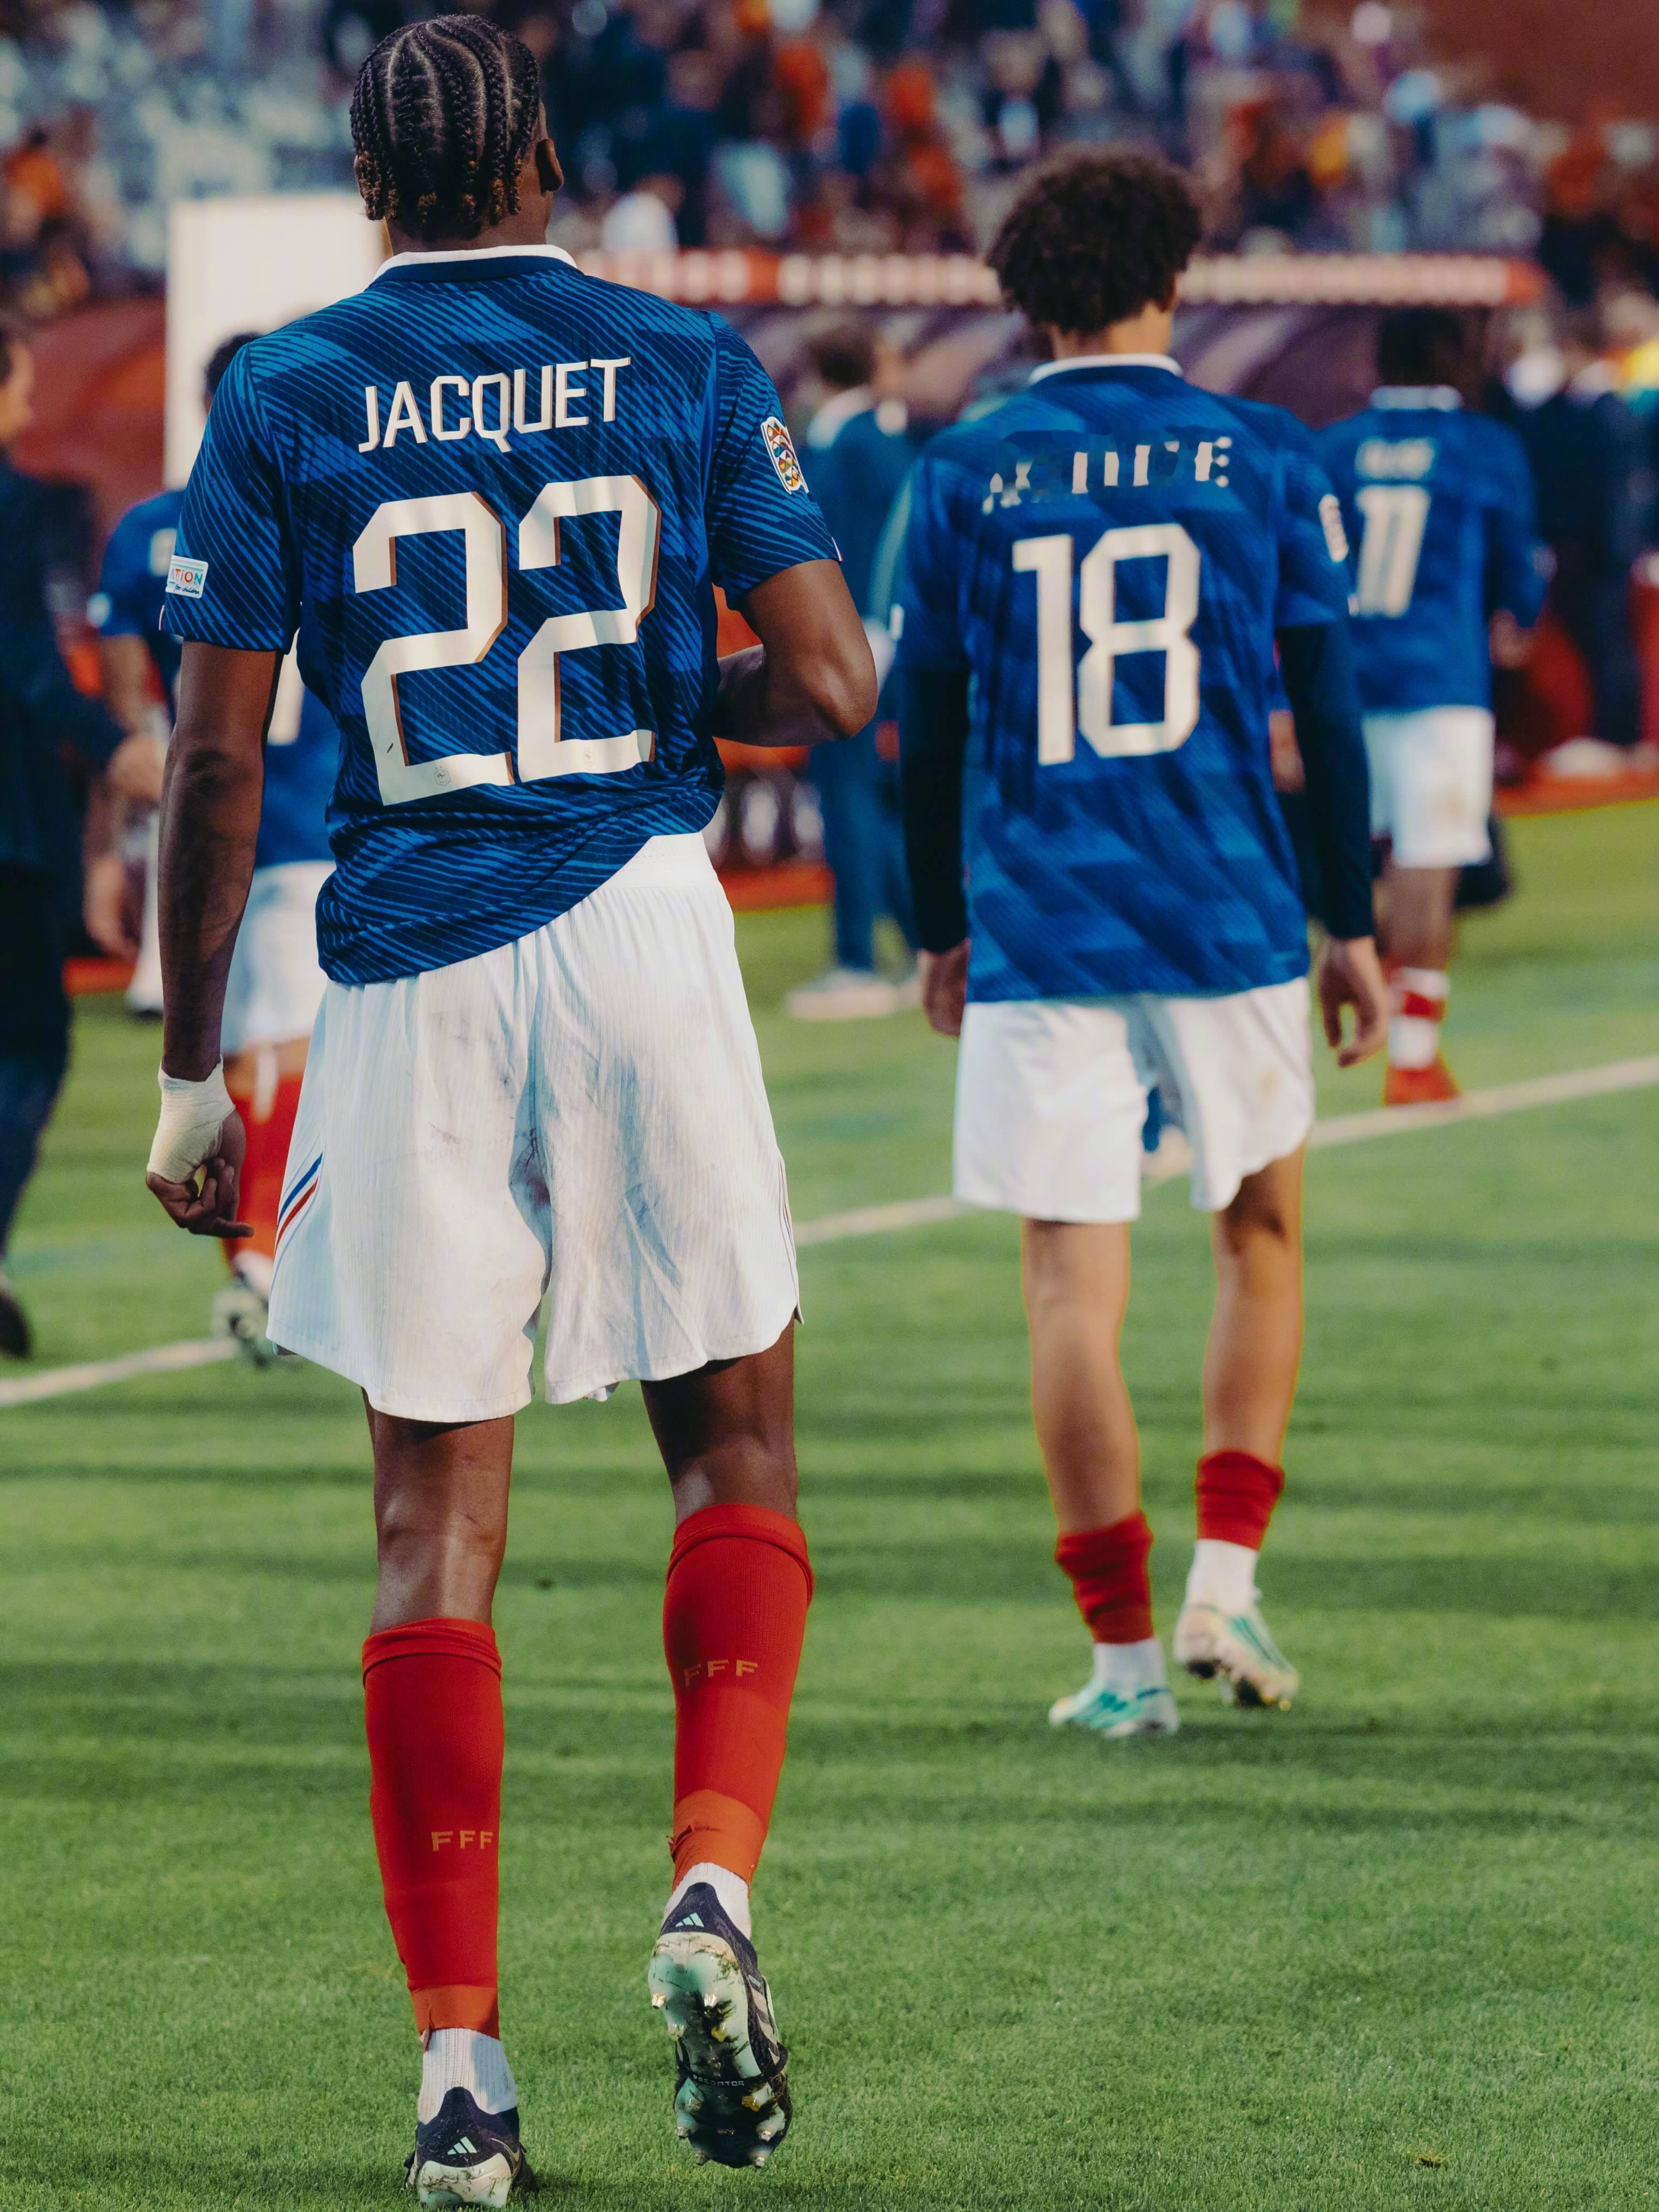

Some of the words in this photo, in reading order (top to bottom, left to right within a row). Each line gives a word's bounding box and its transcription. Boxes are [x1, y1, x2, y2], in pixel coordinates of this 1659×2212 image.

[359, 357, 631, 453] JACQUET
[352, 475, 662, 806] 22
[1011, 522, 1201, 766] 18
[684, 1659, 758, 1687] FFF
[431, 1830, 493, 1851] FFF
